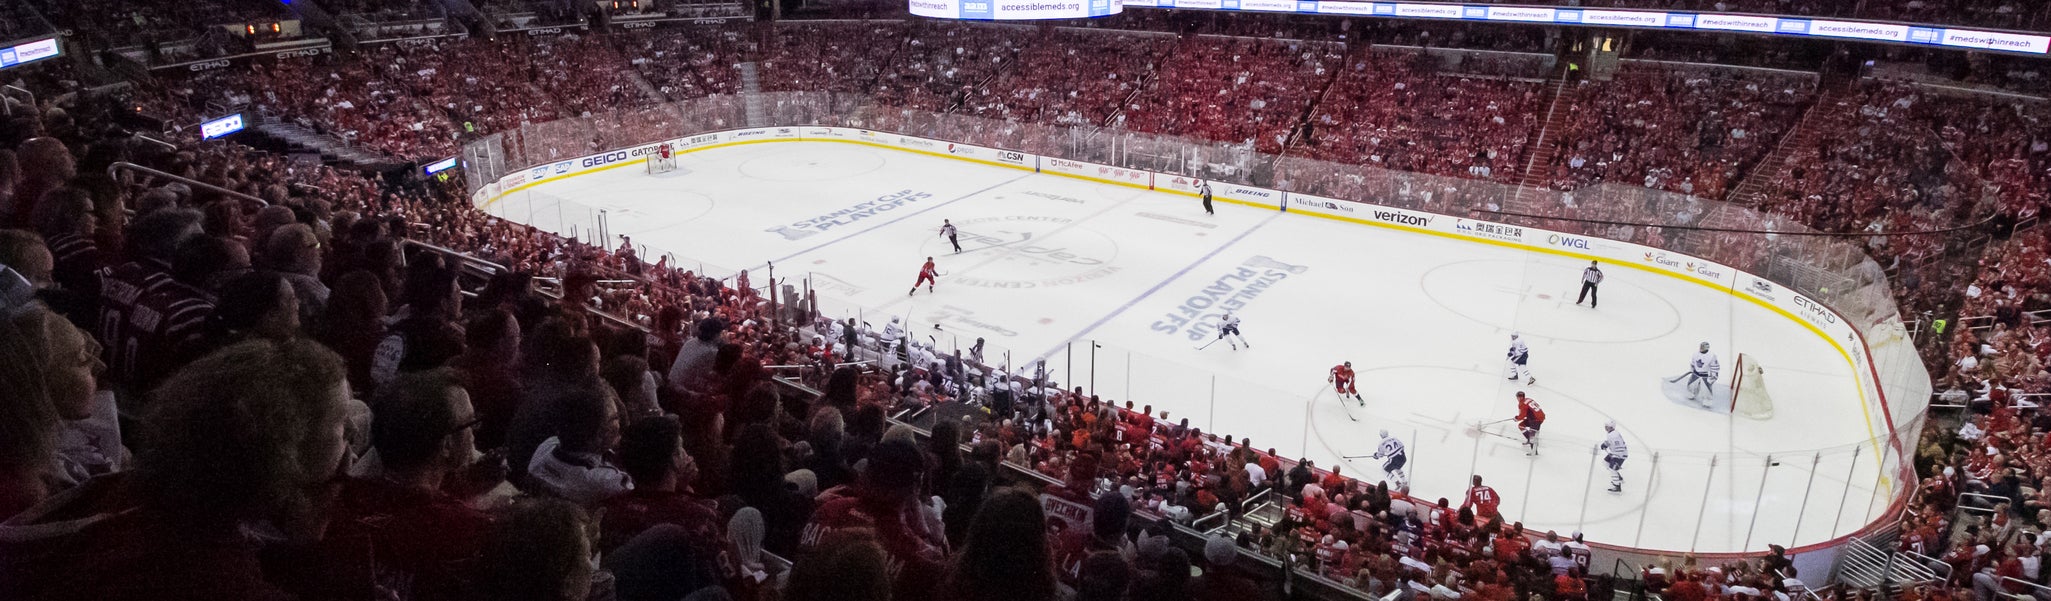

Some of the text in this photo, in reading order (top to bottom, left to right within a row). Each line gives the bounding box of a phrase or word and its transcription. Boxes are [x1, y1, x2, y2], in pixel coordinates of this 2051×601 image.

[1001, 2, 1079, 12] accessiblemeds.org
[1589, 13, 1655, 23] accessiblemeds.org
[1702, 19, 1768, 28] #medswithinreach
[1818, 25, 1898, 38] accessiblemeds.org
[1950, 35, 2031, 48] #medswithinreach
[190, 59, 230, 72] ETIHAD
[632, 142, 675, 158] GATORE
[1006, 152, 1024, 162] CSN
[582, 150, 627, 168] GEICO
[1058, 160, 1083, 169] McAfee
[1236, 188, 1270, 198] BOEING
[792, 189, 913, 229] STANLEY CUP
[815, 191, 933, 231] PLAYOFFS
[1295, 197, 1354, 213] Michael Son
[1374, 209, 1428, 227] verizon
[1561, 236, 1591, 250] WGL
[1655, 255, 1679, 269] Giant
[1697, 266, 1720, 279] Giant
[1218, 269, 1287, 316] STANLEY
[1149, 266, 1259, 336] PLAYOFFS
[1793, 295, 1836, 324] ETIHAD
[1476, 490, 1491, 504] 74
[1045, 498, 1088, 523] OVECHKIN
